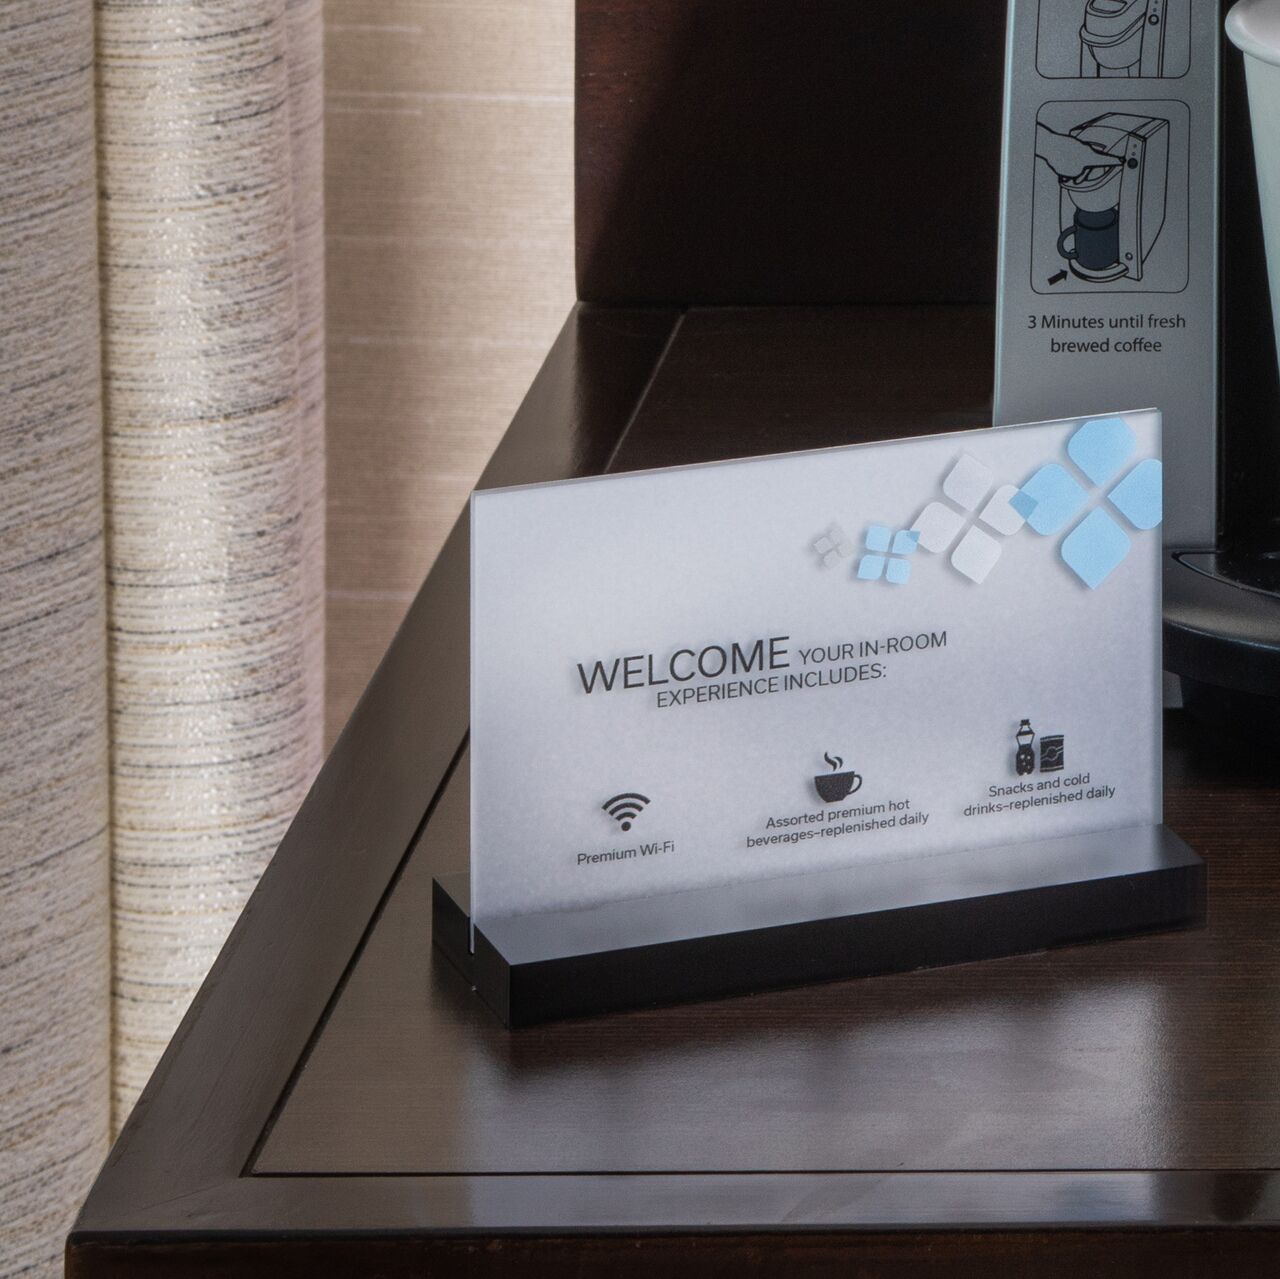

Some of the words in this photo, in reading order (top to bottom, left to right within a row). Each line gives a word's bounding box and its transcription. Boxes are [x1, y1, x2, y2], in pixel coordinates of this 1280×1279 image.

[1028, 315, 1037, 329] 3
[1041, 315, 1105, 329] Minutes
[1109, 314, 1144, 329] until
[1148, 314, 1186, 329] fresh
[1051, 338, 1110, 353] brewed
[1114, 338, 1162, 352] coffee
[576, 636, 790, 695] WELCOME
[798, 643, 854, 665] YOUR
[859, 631, 947, 656] IN-ROOM
[656, 676, 779, 708] EXPERIENCE
[784, 664, 887, 691] INCLUDES:
[989, 782, 1034, 798] Snacks
[1037, 777, 1061, 791] and
[1063, 773, 1091, 788] cold
[1086, 785, 1116, 803] daily
[766, 809, 825, 829] Assorted
[828, 803, 886, 824] premium
[888, 798, 911, 813] hot
[899, 811, 929, 829] daily
[577, 847, 637, 865] Premium
[640, 840, 675, 856] Wi-Fi
